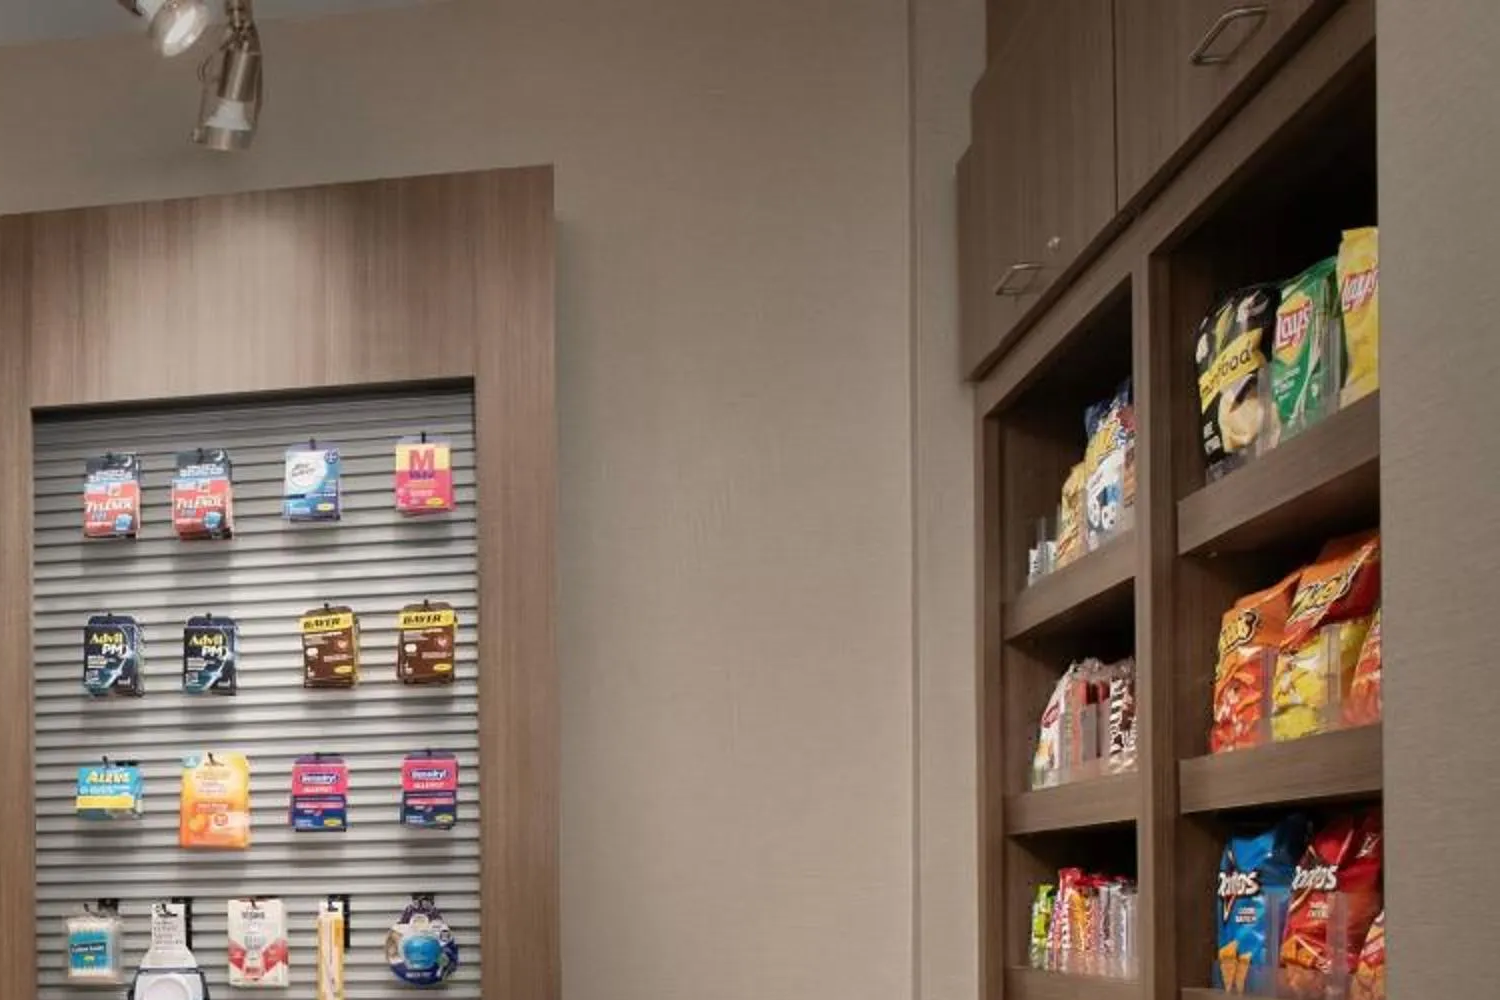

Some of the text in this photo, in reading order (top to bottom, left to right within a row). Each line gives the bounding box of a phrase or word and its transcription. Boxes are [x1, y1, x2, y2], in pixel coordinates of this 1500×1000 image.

[409, 450, 436, 471] M
[303, 617, 342, 629] BAYER
[403, 613, 442, 624] BAYER
[89, 631, 123, 645] Advil
[189, 633, 223, 646] Advil
[102, 643, 124, 656] PM
[201, 646, 223, 657] PM
